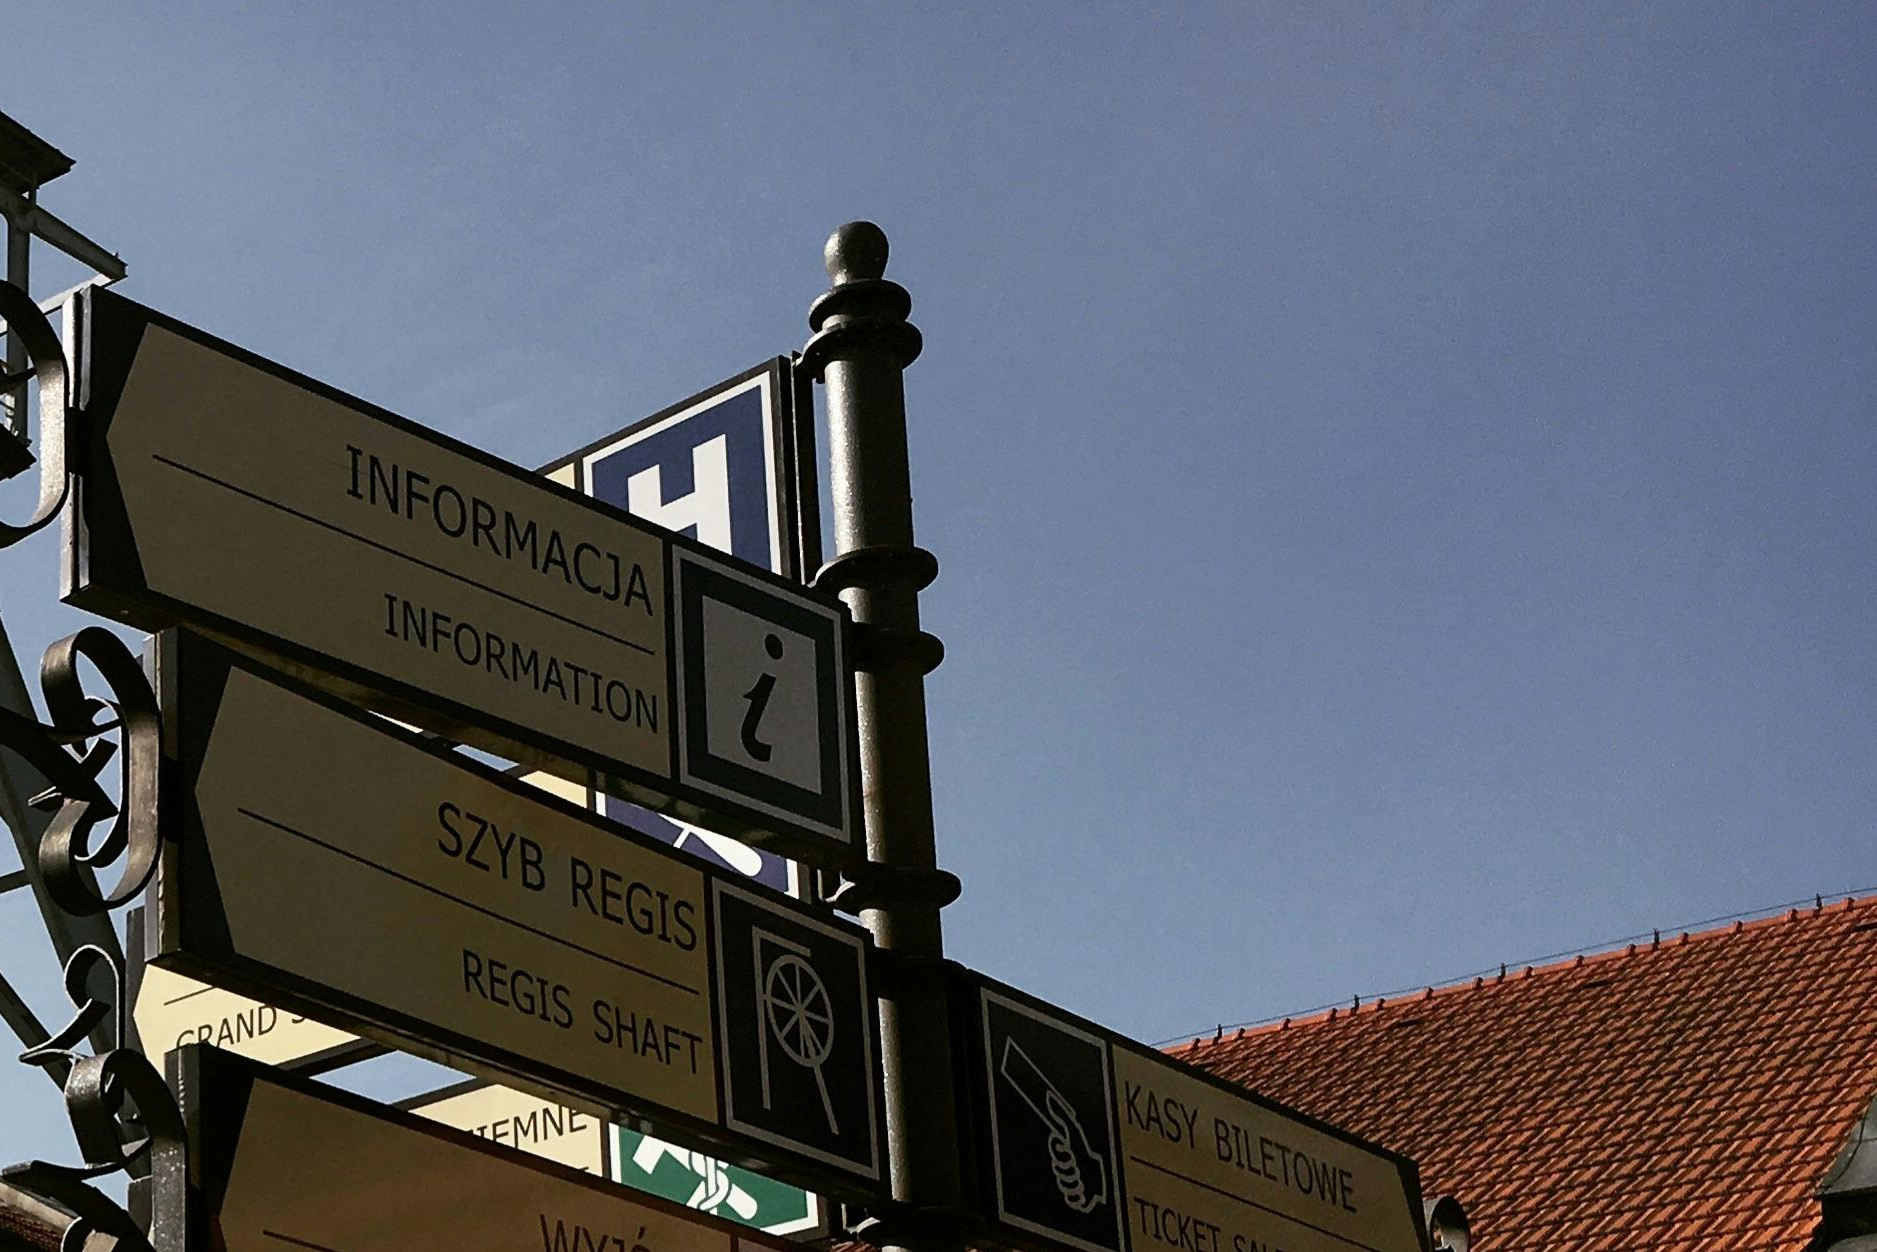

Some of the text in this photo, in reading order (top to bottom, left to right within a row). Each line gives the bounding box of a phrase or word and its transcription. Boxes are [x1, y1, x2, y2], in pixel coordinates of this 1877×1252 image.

[346, 446, 653, 615] INFORMACJA
[384, 594, 659, 734] INFORMATION
[437, 802, 697, 951] SZYB REGIS
[462, 949, 702, 1075] REGIS SHAFT
[1126, 1083, 1357, 1212] KASY BILETOWE
